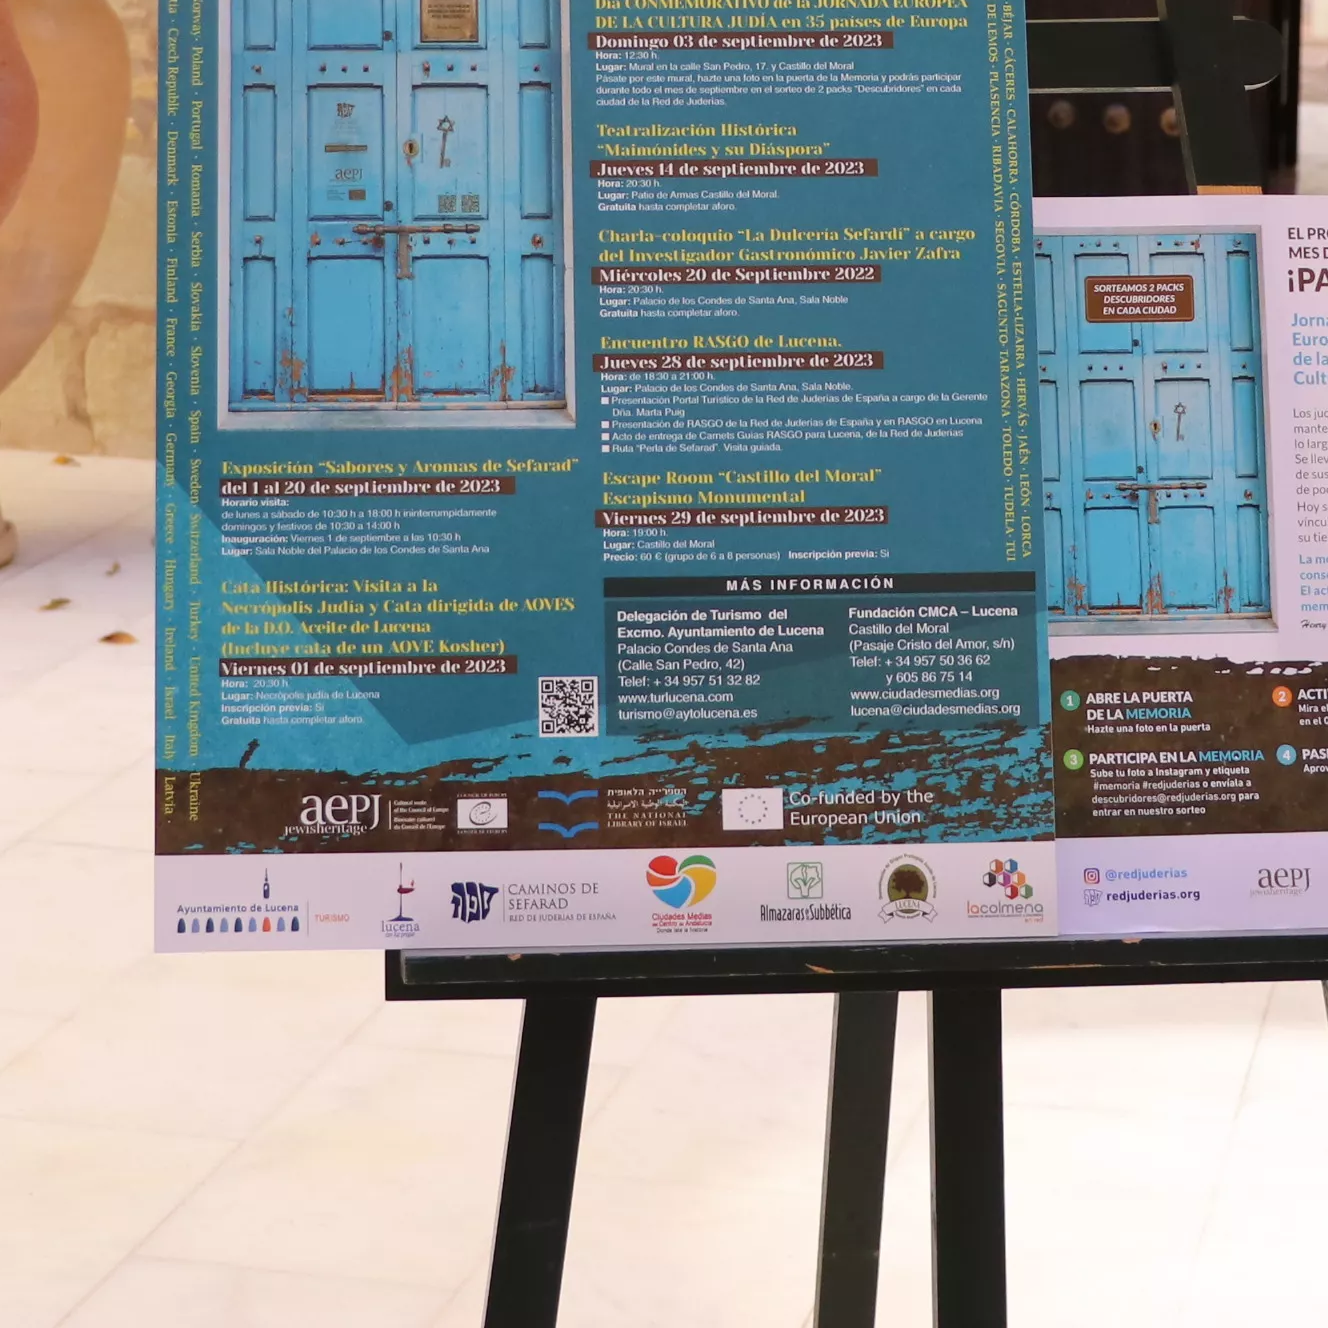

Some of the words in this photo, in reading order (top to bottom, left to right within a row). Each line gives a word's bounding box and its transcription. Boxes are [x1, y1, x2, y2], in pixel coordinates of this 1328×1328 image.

[191, 45, 204, 86] Poland
[189, 99, 203, 150] Portugal
[596, 123, 716, 137] Teatralización
[721, 123, 797, 137] Histórica
[711, 146, 718, 159] y
[724, 146, 745, 156] su
[1006, 107, 1018, 184] CALAHORRA
[167, 131, 179, 186] Denmark
[596, 163, 654, 176] Jueves
[659, 162, 674, 176] 14
[679, 162, 699, 176] de
[703, 162, 797, 178] septiembre
[801, 161, 821, 175] de
[824, 161, 865, 175] 2023
[1287, 227, 1305, 240] EL
[989, 71, 1001, 137] PLASENCIA
[999, 350, 1011, 417] TARAZONA
[1288, 246, 1320, 259] MES
[166, 258, 179, 303] Finland
[1093, 284, 1148, 293] SORTEAMOS
[1156, 283, 1184, 292] PACKS
[1103, 295, 1176, 304] DESCUBRIDORES
[1103, 307, 1115, 315] EN
[1116, 306, 1142, 315] CADA
[1142, 306, 1177, 314] CIUDAD
[1292, 351, 1313, 366] de
[1292, 407, 1312, 419] Los
[222, 461, 314, 478] Exposición
[398, 463, 406, 477] y
[415, 460, 478, 473] Aromas
[482, 459, 503, 473] de
[603, 471, 661, 488] Escape
[666, 471, 714, 485] Room
[794, 469, 820, 483] del
[603, 491, 693, 508] Escapismo
[698, 489, 805, 504] Monumental
[603, 541, 635, 552] Lugar:
[637, 540, 671, 550] Castillo
[673, 540, 687, 549] del
[689, 540, 715, 549] Moral
[726, 577, 762, 591] MÁS
[770, 575, 894, 591] INFORMACIÓN
[615, 625, 665, 638] Excmo.
[667, 624, 756, 640] Ayuntamiento
[758, 625, 775, 637] de
[777, 624, 825, 636] Lucena
[616, 691, 734, 704] www.turlucena.com
[850, 687, 1000, 701] www.ciudadesmedias.org
[1086, 692, 1121, 705] ABRE
[1123, 692, 1141, 704] LA
[1142, 691, 1193, 704] PUERTA
[618, 706, 758, 721] turismo@aytolucena.es
[850, 703, 1021, 718] lucena@ciudadesmedias.org
[1087, 709, 1106, 721] DE
[1107, 708, 1124, 720] LA
[1126, 707, 1192, 720] MEMORIA
[189, 772, 203, 821] Ukraine
[788, 789, 875, 808] Co-funded
[878, 789, 901, 806] by
[903, 789, 935, 804] the
[1091, 793, 1236, 805] descubridores@redjuderias.org
[789, 811, 867, 828] European
[875, 809, 922, 825] Union
[1104, 867, 1188, 882] @redjuderias
[507, 882, 576, 896] CAMINOS
[581, 882, 599, 895] DE
[1106, 889, 1201, 903] redjuderias.org
[176, 904, 247, 915] Ayuntamiento
[249, 903, 262, 913] de
[265, 903, 299, 913] Lucena
[508, 897, 569, 910] SEFARAD
[314, 914, 350, 922] TURISMO
[652, 912, 685, 922] Ciudades
[687, 911, 713, 921] Medias
[760, 904, 805, 922] Almazaras
[809, 902, 853, 921] Subbética
[381, 920, 420, 932] lucena
